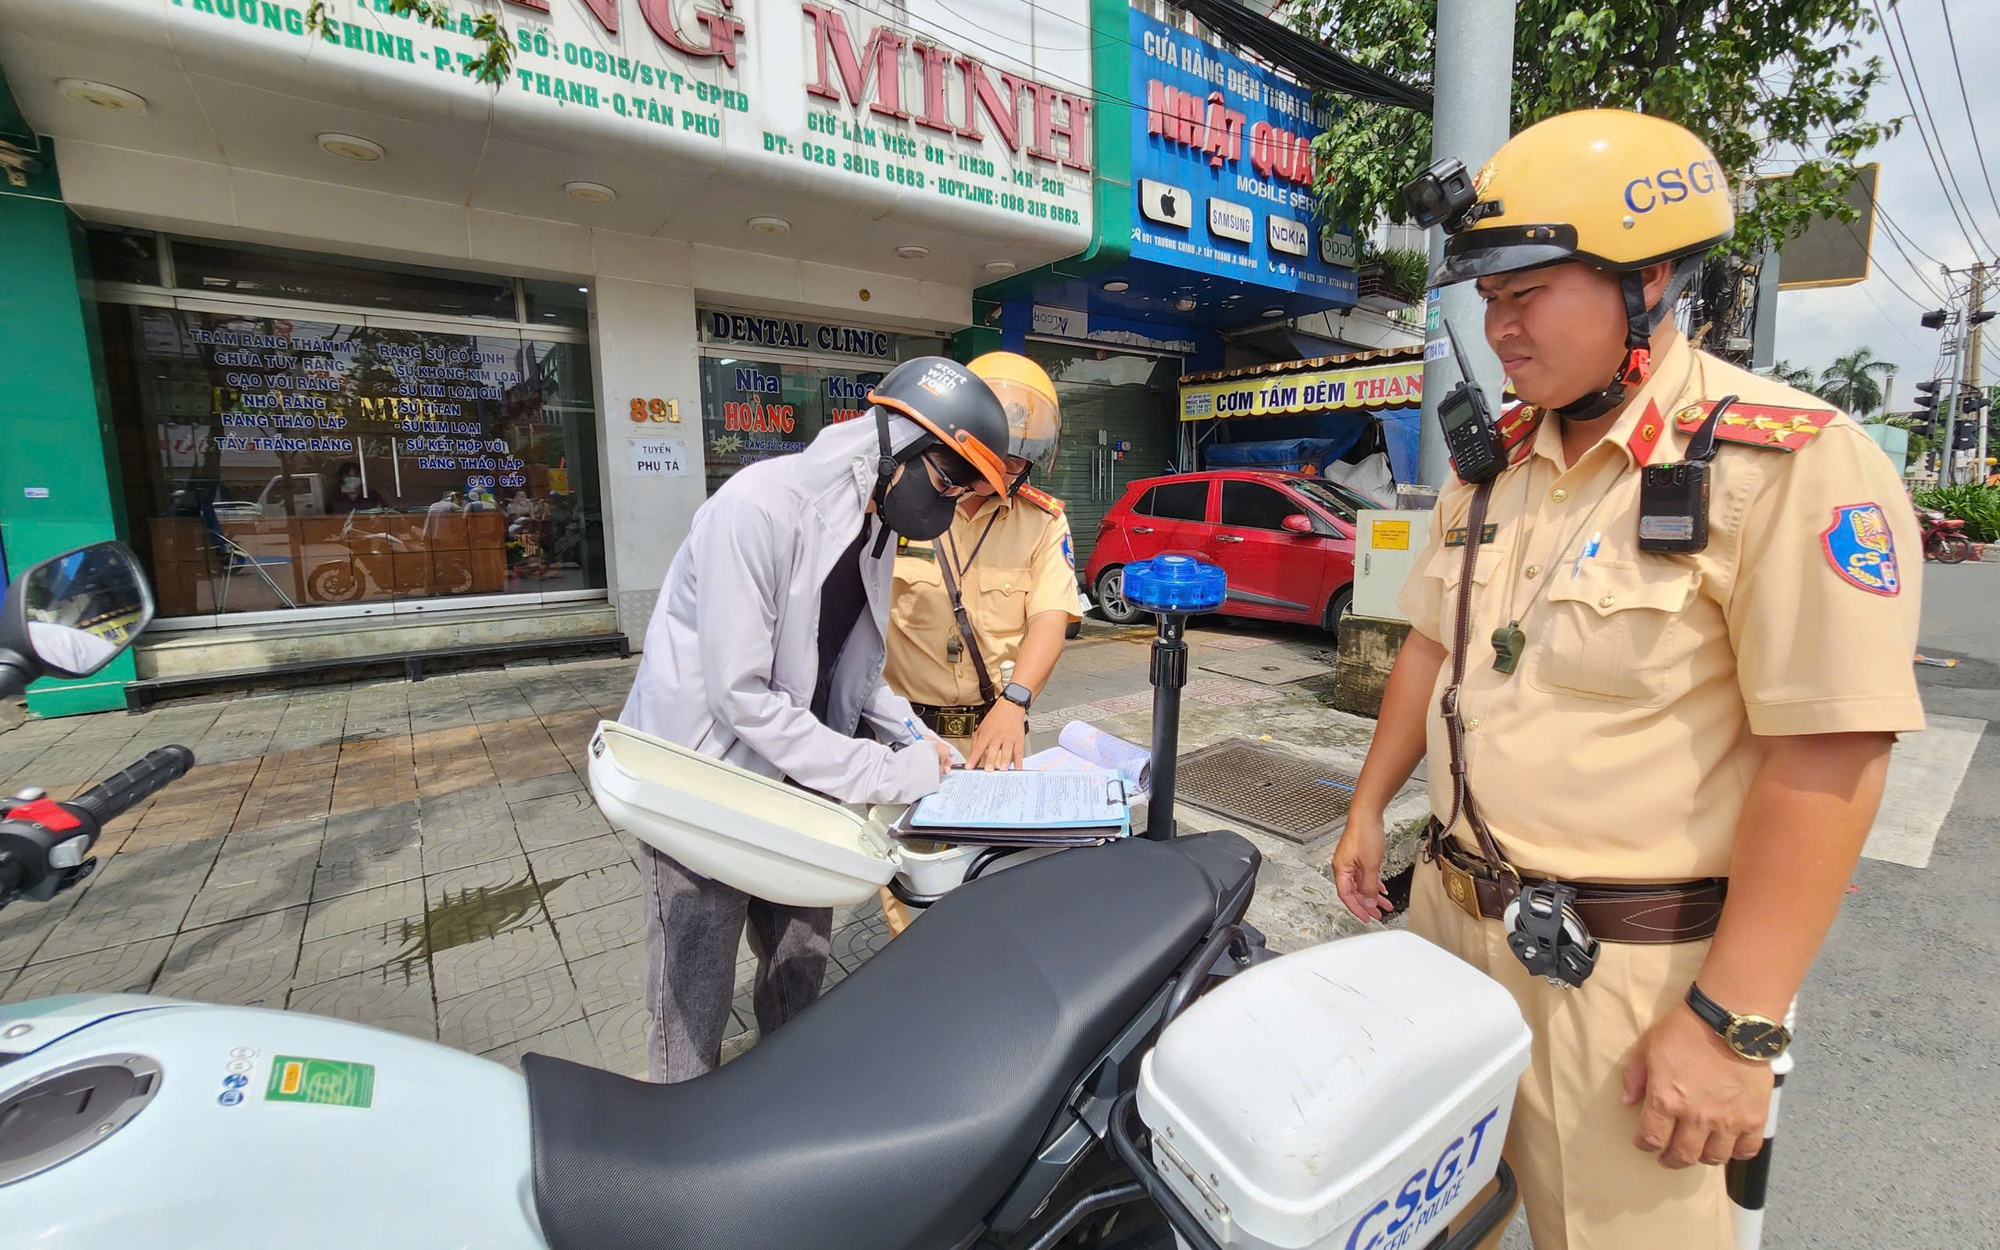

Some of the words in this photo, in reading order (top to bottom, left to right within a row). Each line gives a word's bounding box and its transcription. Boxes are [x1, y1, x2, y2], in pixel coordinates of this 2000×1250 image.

[802, 2, 1093, 172] MINH
[1143, 27, 1179, 69] CỬA
[1181, 48, 1226, 87] HÀNG
[1227, 67, 1261, 103] ĐIỆN
[1262, 82, 1300, 120] THOẠI
[1301, 100, 1316, 126] DI
[681, 110, 721, 138] PHÚ
[1147, 79, 1247, 168] NHẬT
[842, 118, 877, 148] LÀM
[882, 132, 917, 159] VIỆC
[924, 144, 945, 166] 8H
[801, 141, 837, 168] 028
[843, 152, 880, 179] 3815
[885, 163, 926, 190] 6563
[1236, 175, 1288, 205] MOBILE
[1212, 208, 1251, 235] SAMSUNG
[1272, 225, 1307, 248] NOKIA
[711, 312, 811, 350] DENTAL
[816, 325, 889, 358] CLINIC
[472, 352, 506, 367] ĐỊNH
[227, 373, 262, 391] CẠO
[265, 374, 293, 388] VÔI
[417, 365, 464, 381] KHÔNG
[466, 369, 492, 383] KIM
[494, 371, 523, 387] LOẠI
[735, 367, 780, 394] Nha
[927, 368, 957, 390] with
[934, 362, 968, 385] start
[420, 385, 446, 398] KIM
[448, 387, 478, 402] LOẠI
[1216, 391, 1254, 412] CƠM
[1260, 381, 1297, 408] TẤM
[1303, 380, 1346, 404] ĐÊM
[221, 411, 269, 427] RĂNG
[271, 411, 316, 429] THÁO
[318, 412, 348, 430] LẮP
[629, 397, 683, 423] 891
[723, 395, 796, 434] HOÀNG
[423, 421, 449, 434] KIM
[451, 423, 482, 437] LOẠI
[214, 431, 249, 450] TẨY
[252, 433, 306, 451] TRẮNG
[308, 436, 353, 452] RĂNG
[428, 436, 453, 452] KẾT
[642, 441, 672, 454] TUYỂN
[418, 455, 457, 470] RĂNG
[459, 456, 497, 470] THÁO
[499, 454, 525, 471] LẮP
[637, 460, 661, 473] PHỤ
[664, 458, 680, 471] TÁ
[467, 476, 497, 488] CAO
[499, 471, 527, 489] CẤP
[1415, 1176, 1465, 1234] POLICE
